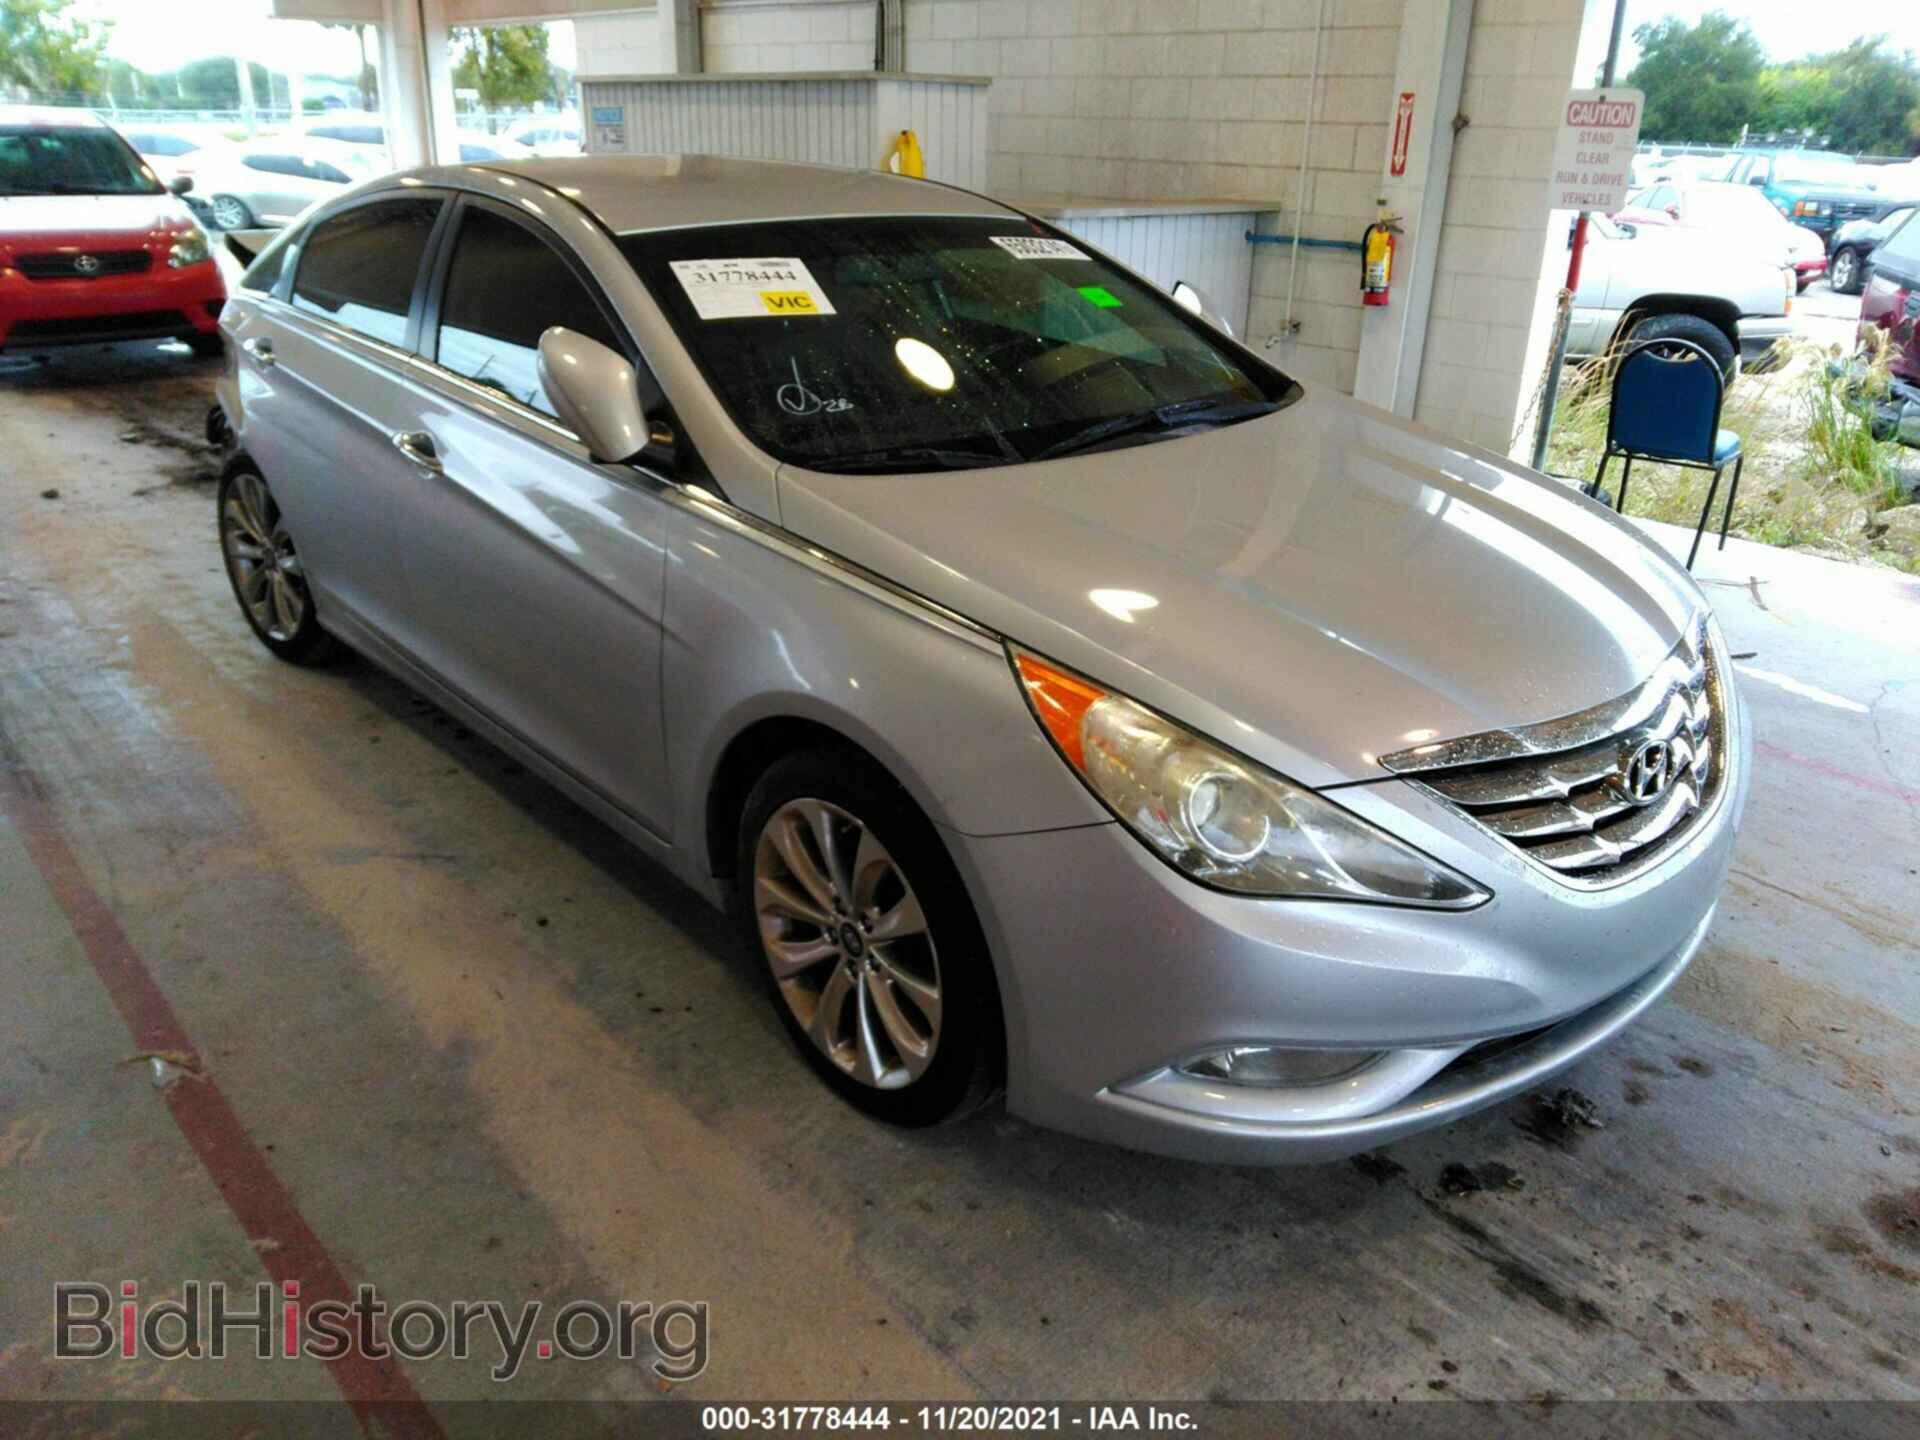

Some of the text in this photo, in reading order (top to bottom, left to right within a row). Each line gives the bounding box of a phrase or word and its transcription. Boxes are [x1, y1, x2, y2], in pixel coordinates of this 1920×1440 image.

[1569, 103, 1634, 125] CAUTION
[1579, 131, 1614, 144] STAND
[1576, 152, 1610, 165] CLEAR
[1555, 171, 1578, 184] RUN
[1592, 173, 1624, 186] DRIVE
[1562, 192, 1611, 205] VEHICLES
[692, 270, 797, 283] 31778444
[766, 296, 811, 309] VIC
